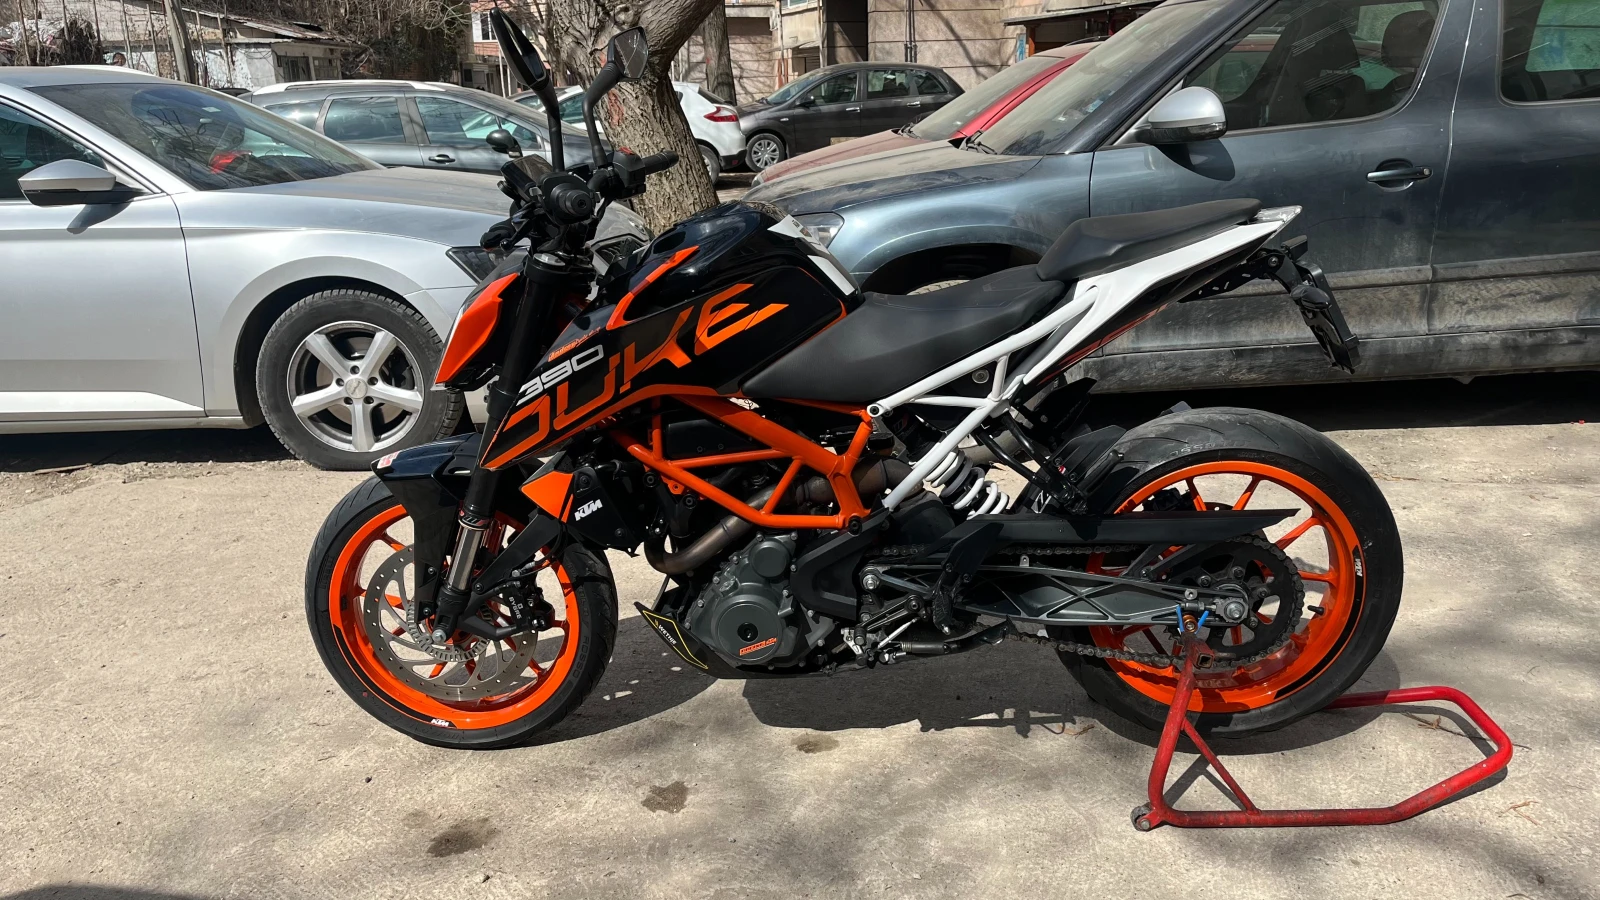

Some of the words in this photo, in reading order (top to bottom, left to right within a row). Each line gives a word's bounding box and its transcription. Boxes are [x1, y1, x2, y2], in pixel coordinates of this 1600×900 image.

[481, 283, 789, 470] DUKE
[516, 344, 604, 406] 390
[575, 499, 603, 522] KTM
[1355, 558, 1363, 577] KTM
[431, 718, 450, 727] KTM
